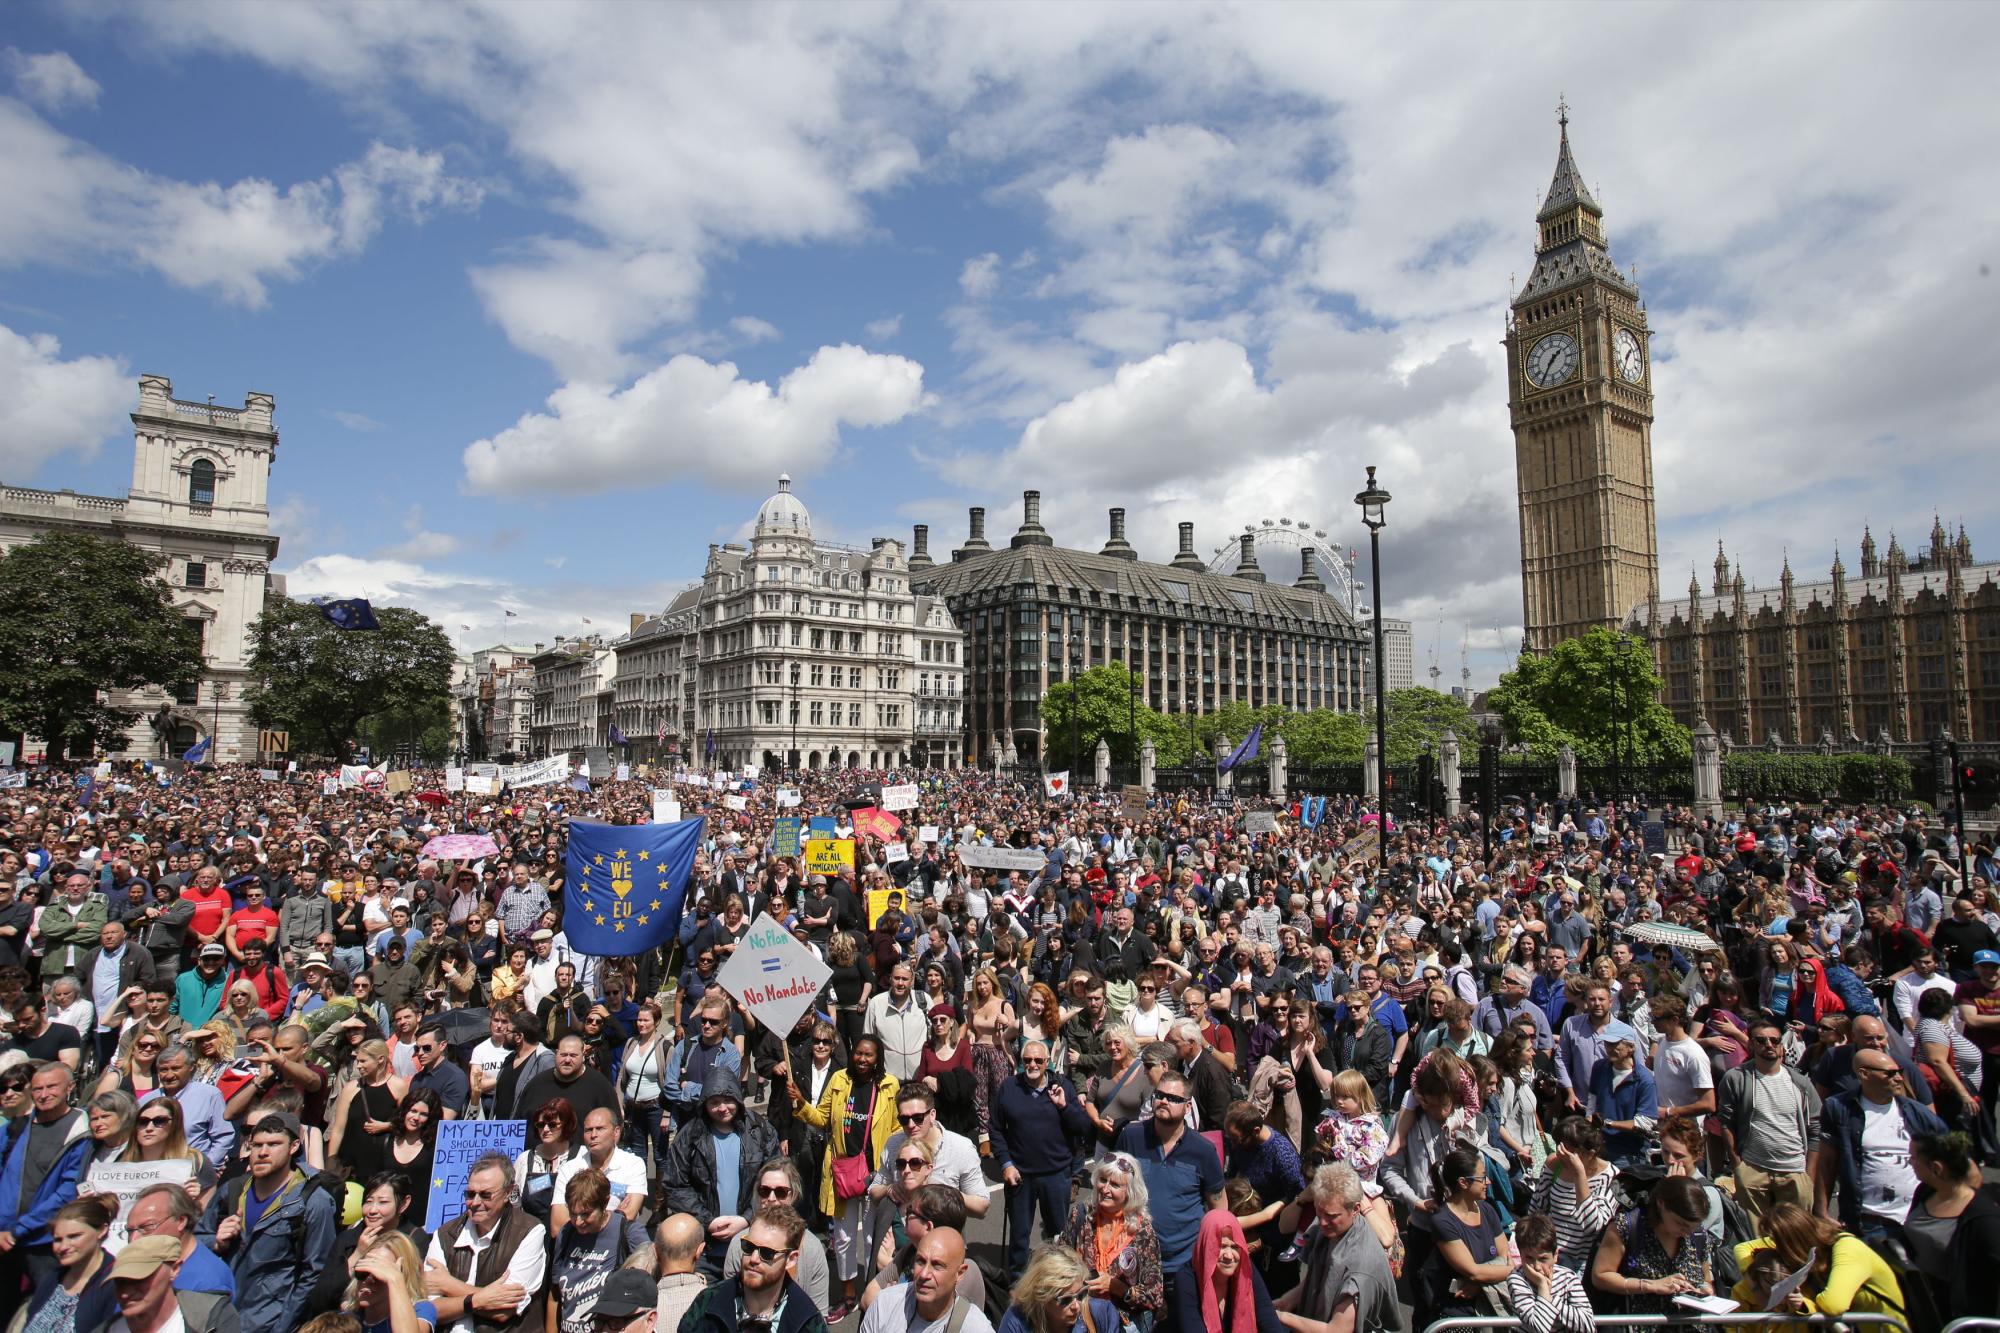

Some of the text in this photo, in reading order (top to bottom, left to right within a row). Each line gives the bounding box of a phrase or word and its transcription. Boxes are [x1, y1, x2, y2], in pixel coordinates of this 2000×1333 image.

[263, 731, 286, 751] IN
[502, 767, 515, 775] NO
[520, 761, 545, 773] PLAN
[520, 769, 564, 783] MANDATE
[824, 842, 836, 851] WE
[816, 852, 841, 861] ARE ALL
[611, 861, 632, 878] WE
[613, 901, 632, 919] EU
[749, 929, 789, 950] No Plan
[743, 988, 765, 1006] No
[764, 975, 817, 1001] Mandate
[443, 1122, 527, 1139] MY FUTURE
[450, 1138, 507, 1150] SHOULD BE
[98, 1172, 121, 1181] LOVE
[123, 1170, 161, 1180] EUROPE
[120, 1192, 141, 1201] OVE
[570, 1246, 610, 1262] Original
